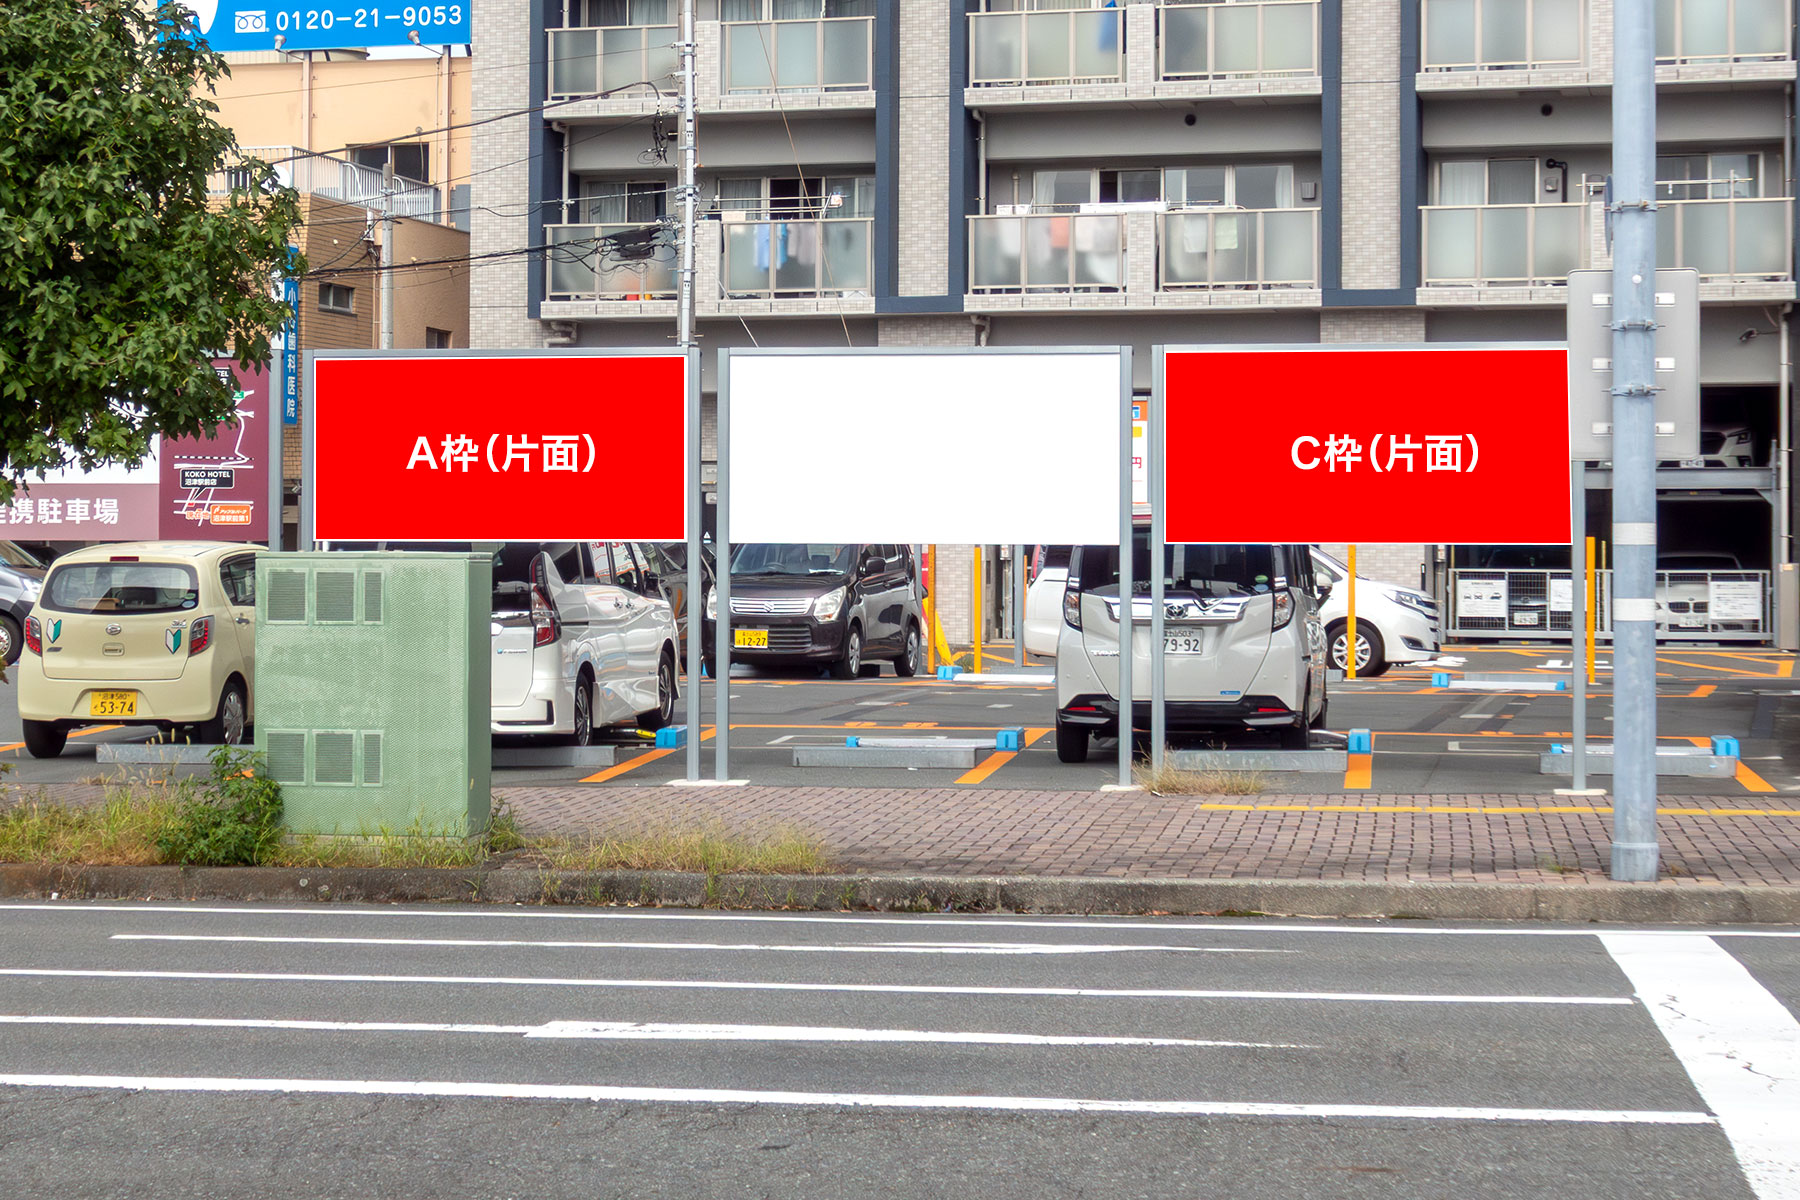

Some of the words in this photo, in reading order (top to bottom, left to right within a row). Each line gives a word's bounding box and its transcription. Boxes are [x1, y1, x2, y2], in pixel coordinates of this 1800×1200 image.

[275, 4, 462, 31] 0120-21-9053
[743, 637, 766, 646] 12-27
[100, 701, 134, 714] 53-74
